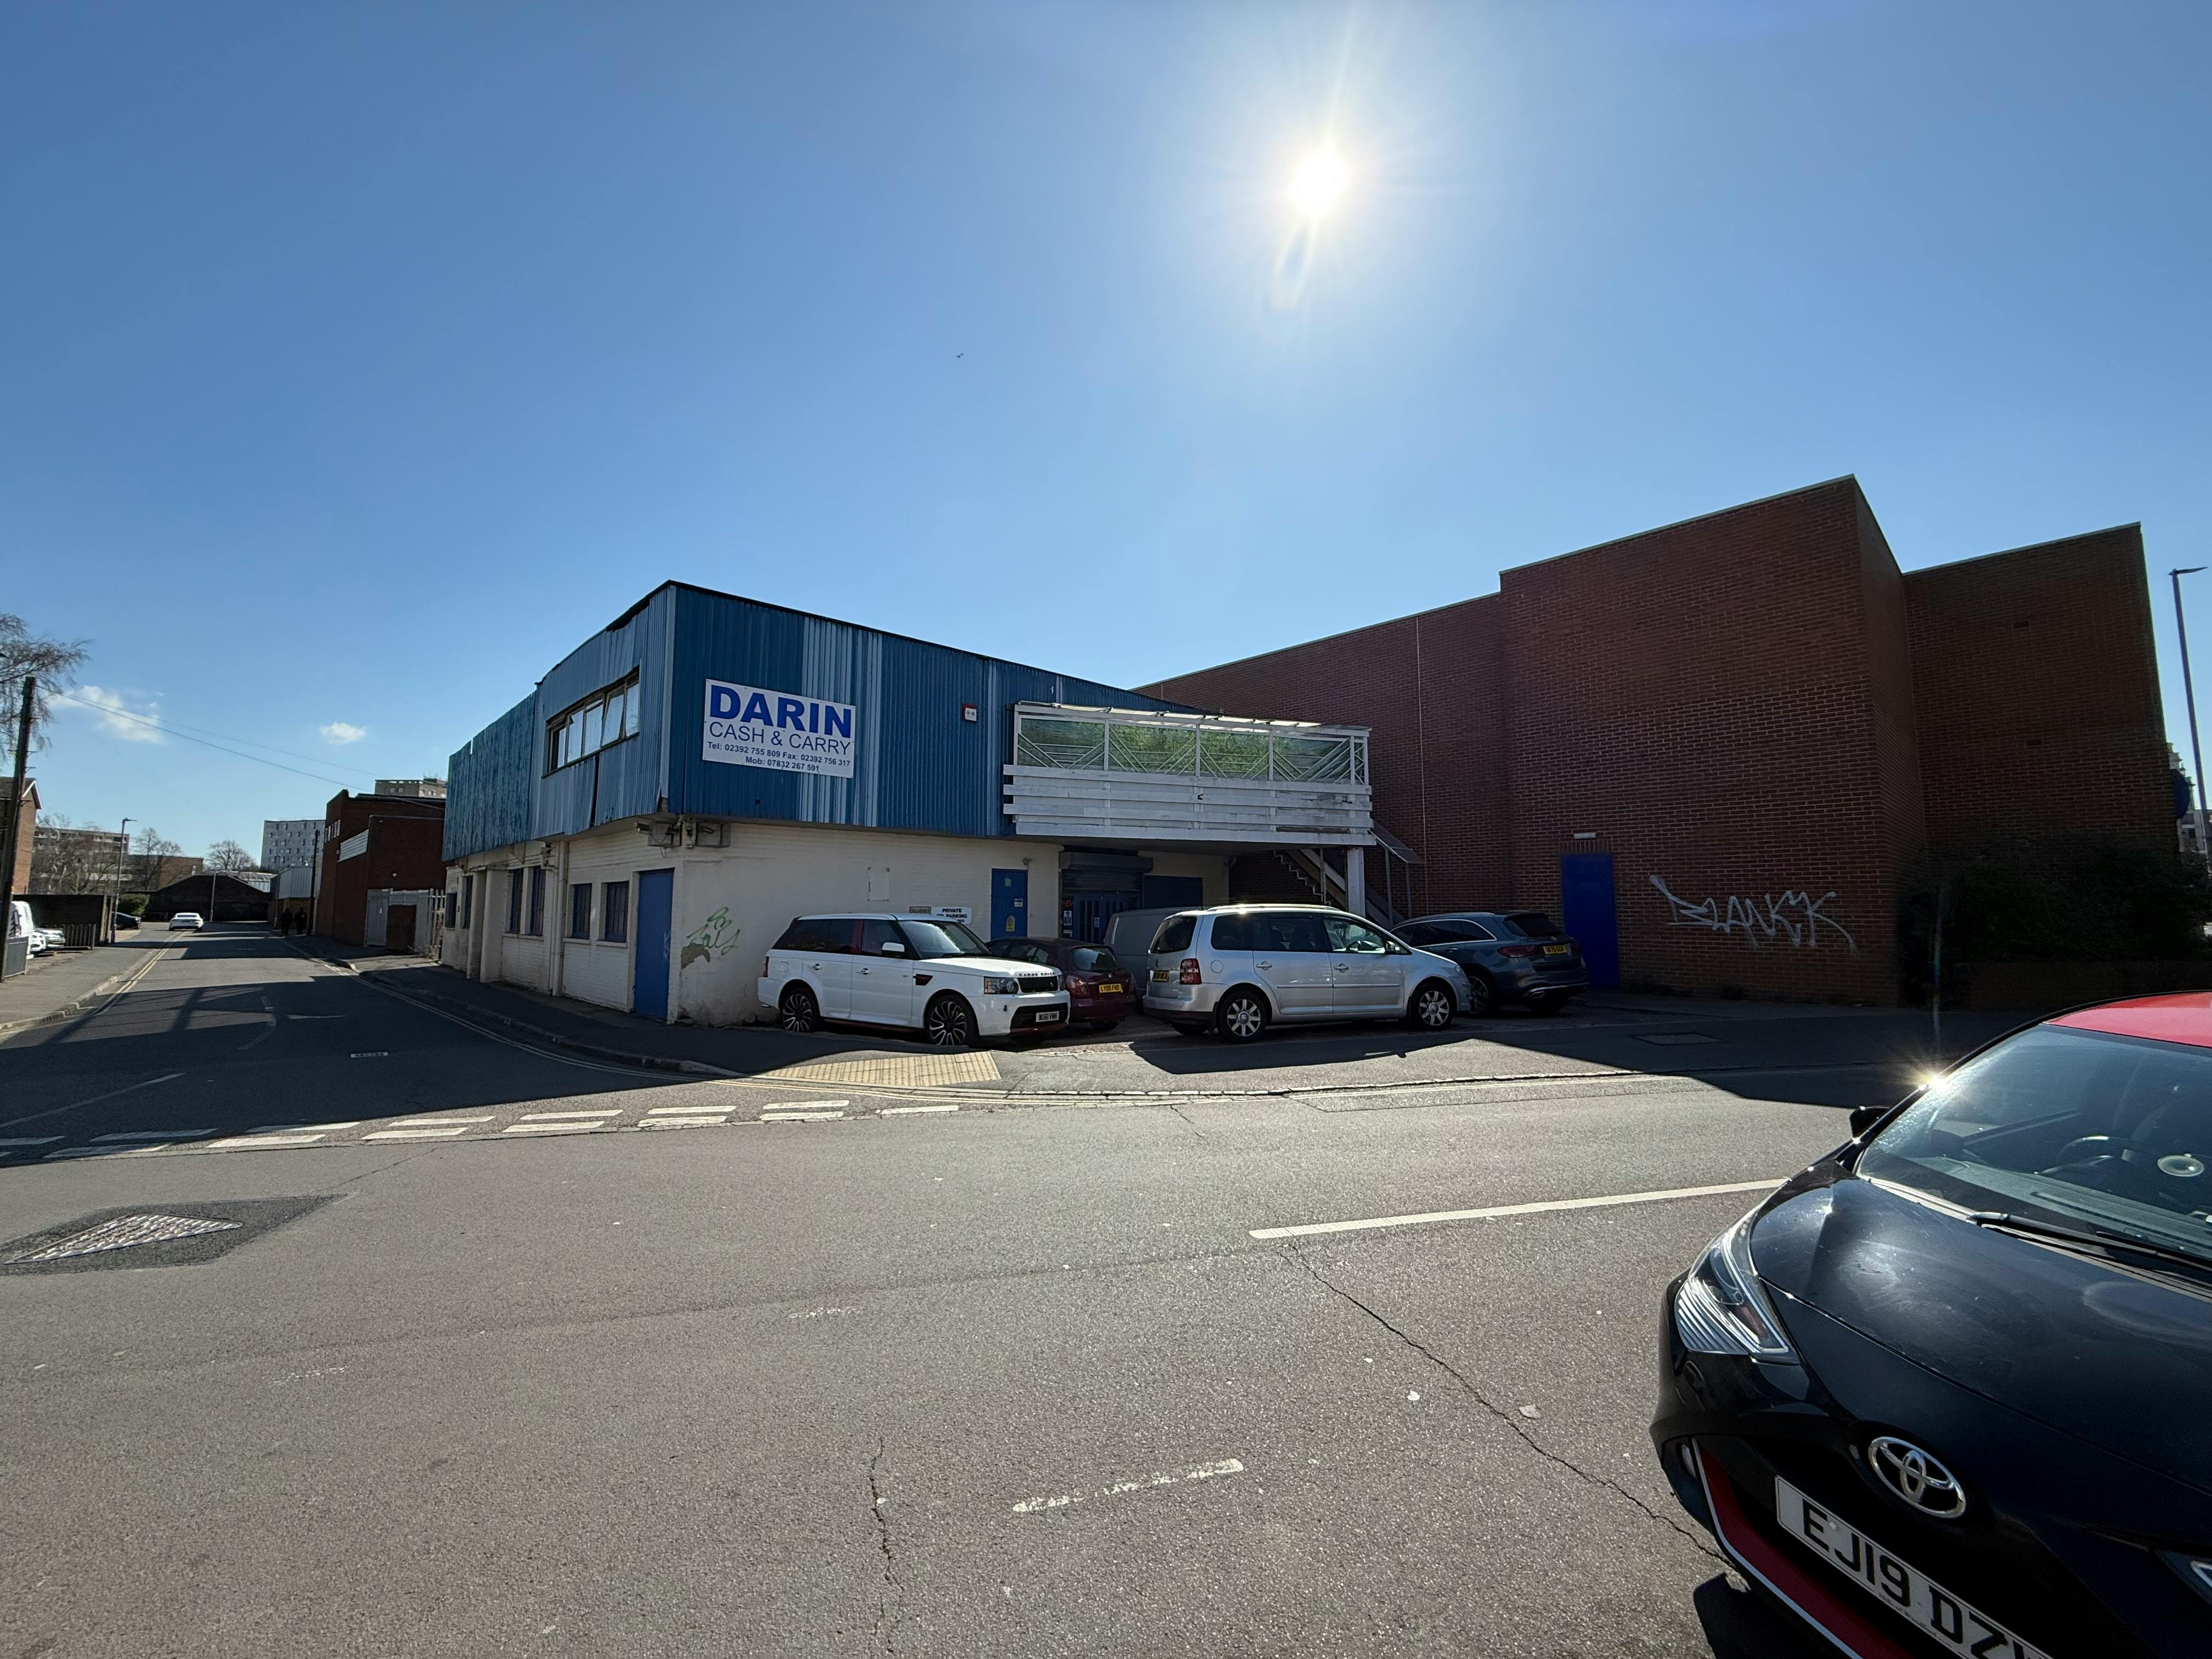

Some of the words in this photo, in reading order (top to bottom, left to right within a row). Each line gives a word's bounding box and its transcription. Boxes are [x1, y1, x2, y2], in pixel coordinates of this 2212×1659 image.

[710, 684, 851, 738] DARIN
[708, 741, 722, 751] Tel:
[725, 743, 748, 754] 02392
[751, 747, 765, 756] 755
[767, 749, 781, 758] 809
[783, 752, 799, 760] Fax:
[801, 754, 822, 763] 02392
[824, 757, 837, 766] 756
[838, 759, 851, 767] 317
[709, 721, 764, 743] CASH
[771, 731, 783, 746] &
[789, 733, 851, 755] CARRY
[746, 756, 765, 766] Mob:
[768, 759, 789, 768] 07832
[792, 761, 805, 770] 267
[807, 764, 820, 772] 591
[1802, 1497, 1911, 1607] EJ19
[1928, 1583, 2042, 1659] DZ
